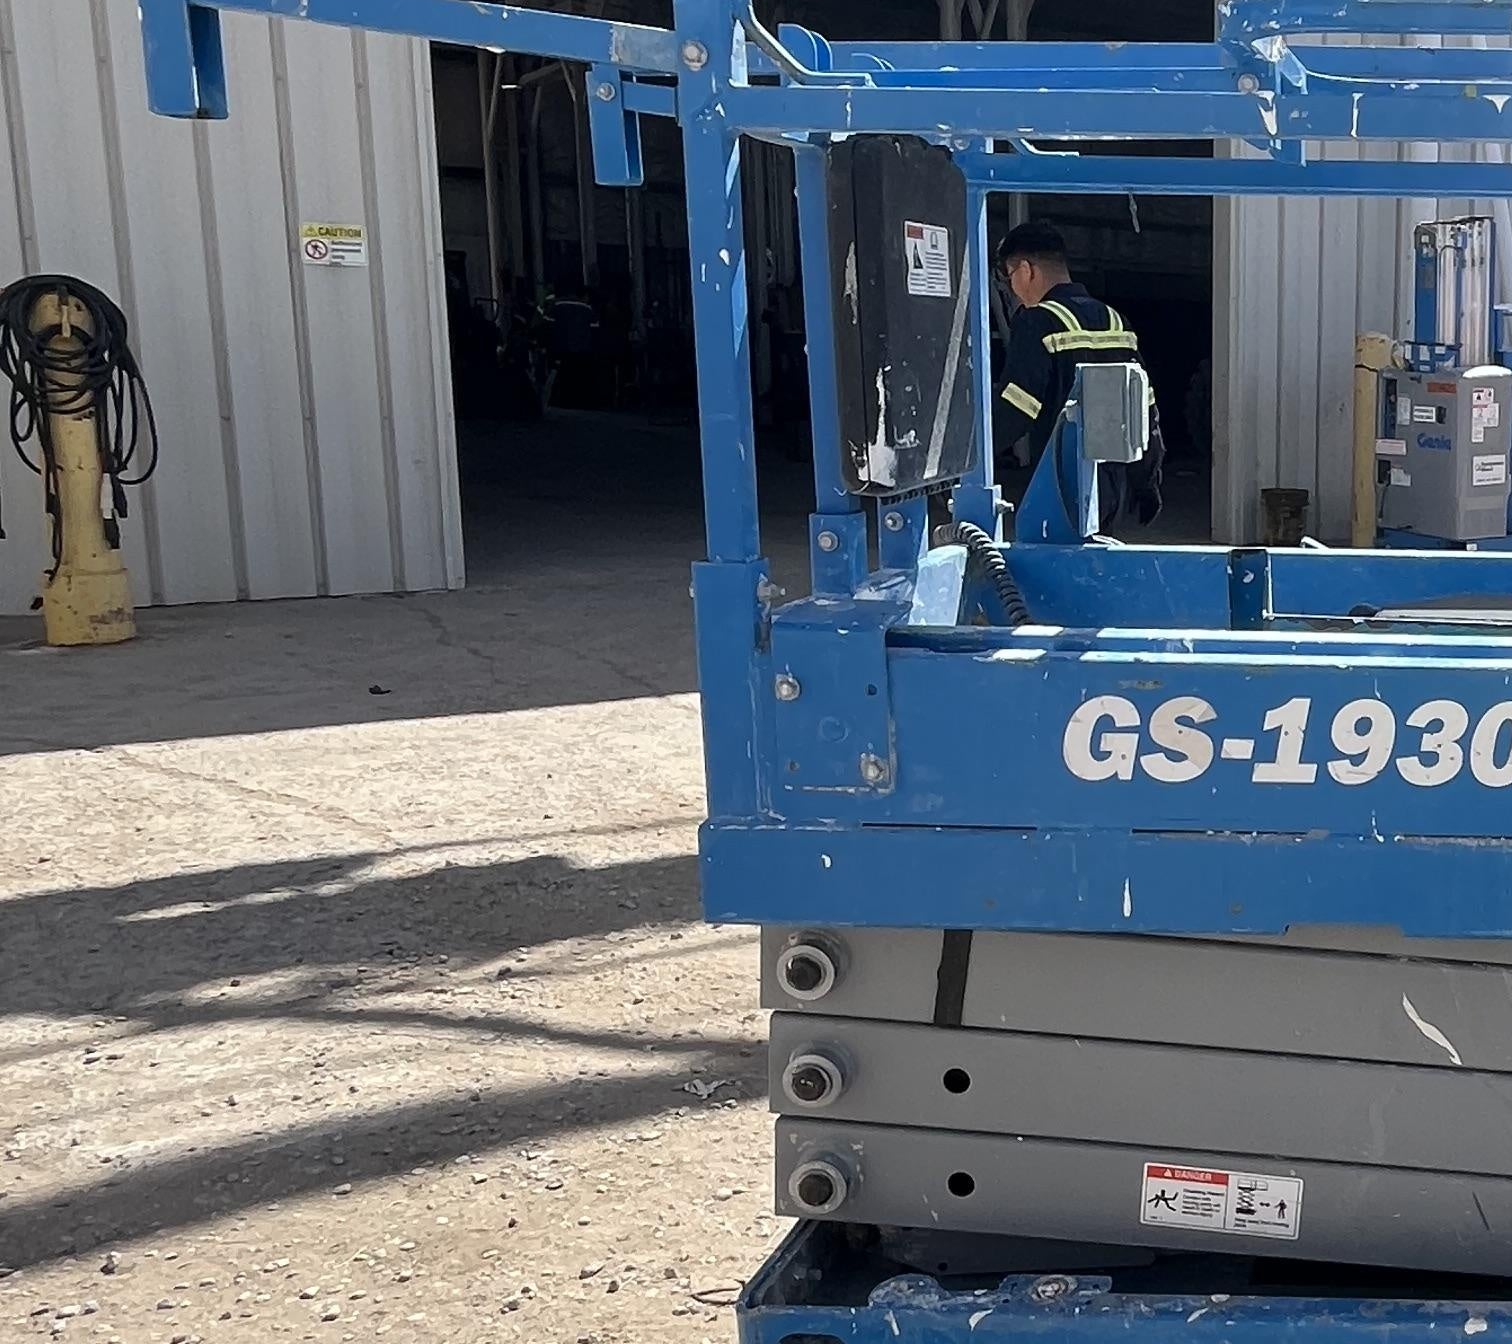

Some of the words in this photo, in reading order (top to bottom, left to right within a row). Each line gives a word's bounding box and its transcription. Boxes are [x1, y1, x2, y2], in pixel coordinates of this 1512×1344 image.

[318, 227, 362, 237] CAUTION
[1417, 433, 1451, 451] Genie
[1174, 1171, 1212, 1181] DANGER
